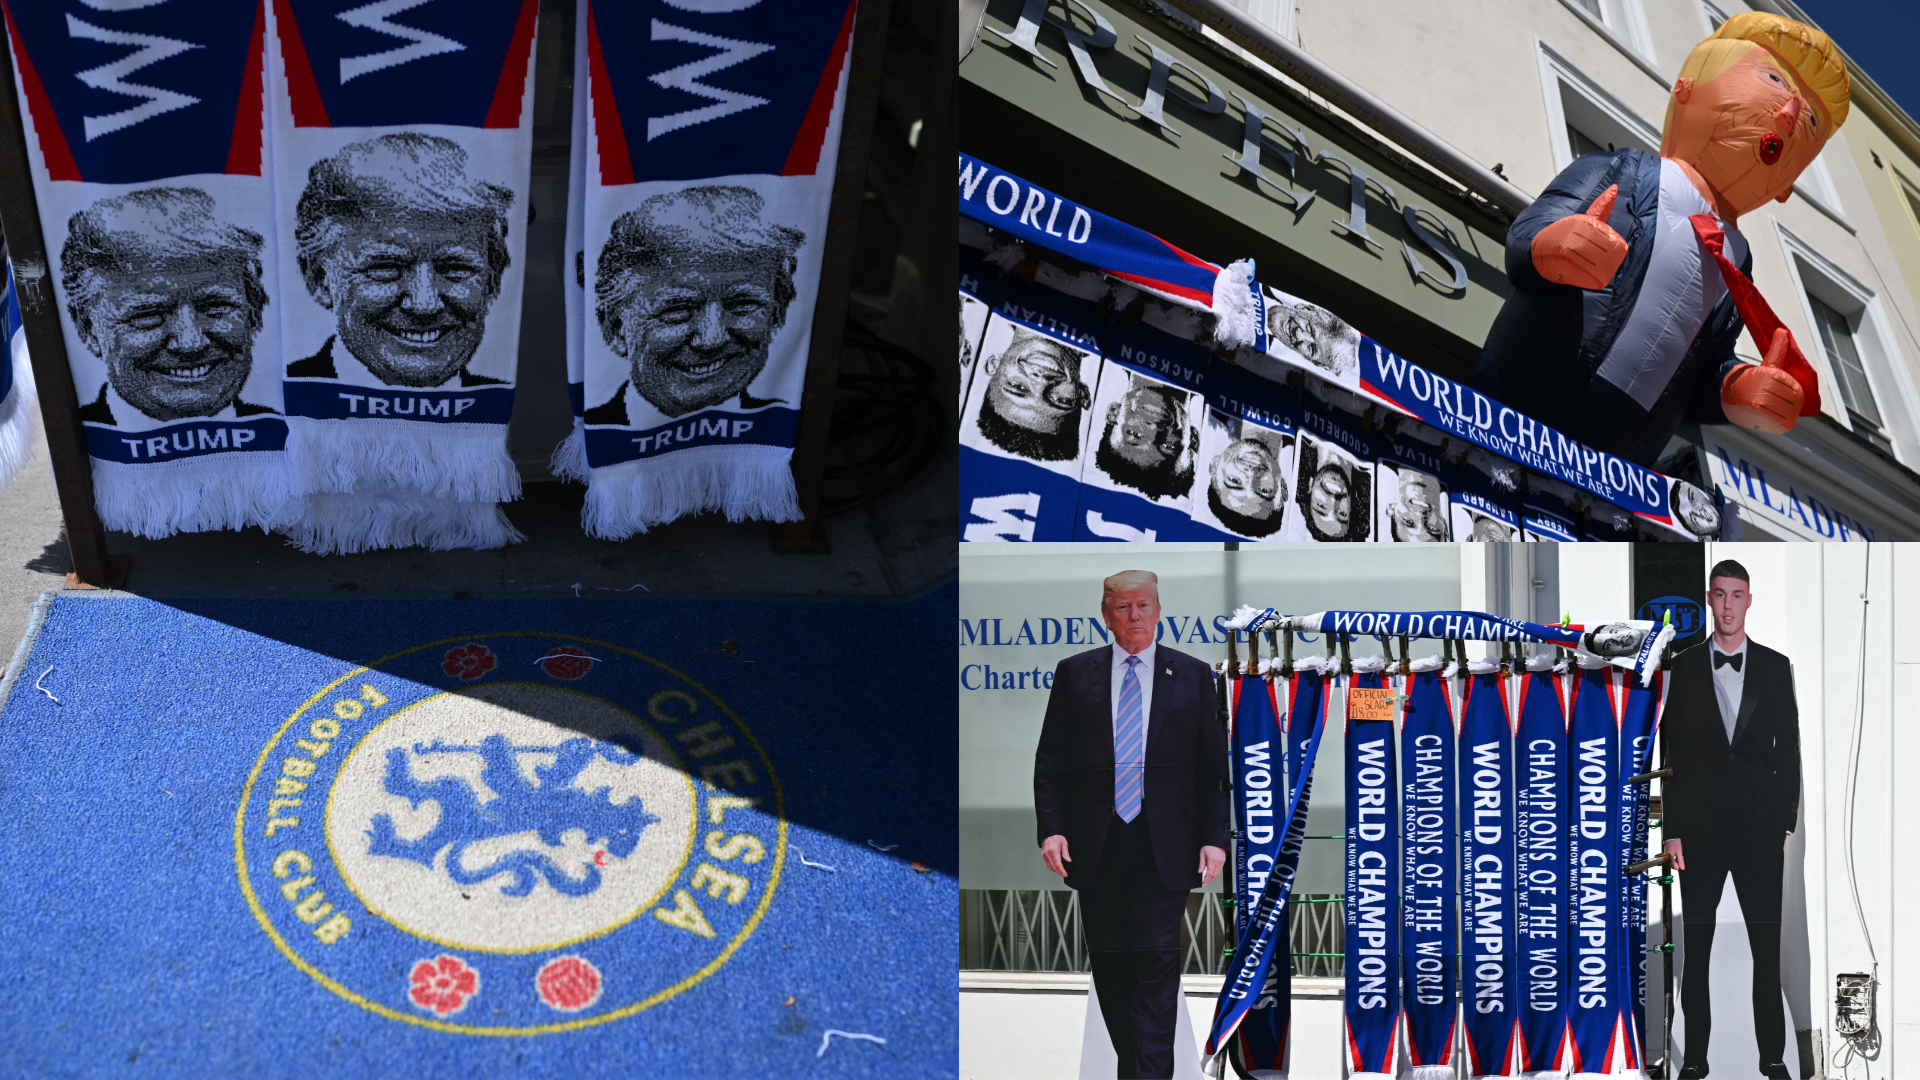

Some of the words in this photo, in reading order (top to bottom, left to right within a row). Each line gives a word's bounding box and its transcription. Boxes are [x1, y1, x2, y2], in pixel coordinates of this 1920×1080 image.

[959, 156, 1092, 244] WORLD
[1003, 301, 1099, 350] WILLIAN
[1250, 291, 1263, 337] TRUMP
[1121, 344, 1204, 385] JACKSON
[339, 393, 476, 418] TRUMP
[1219, 394, 1292, 430] COLWILL
[632, 418, 754, 453] TRUMP
[1304, 409, 1370, 455] CUCURELLA
[1373, 343, 1492, 430] WORLD
[1499, 407, 1660, 507] CHAMPIONS
[121, 428, 256, 458] TRUMP
[1394, 444, 1441, 472] SILVA
[1438, 410, 1465, 435] WE
[1468, 424, 1513, 456] KNOW
[1517, 446, 1558, 475] WHAT
[1560, 465, 1585, 486] WE
[1588, 479, 1614, 500] ARE
[1463, 491, 1514, 522] LAMPARD
[1334, 612, 1423, 637] WORLD
[1429, 613, 1532, 643] CHAMP
[1639, 631, 1658, 664] PALMER
[961, 664, 1055, 691] Charte
[265, 683, 390, 837] FOOTBALL
[1244, 741, 1274, 844] WORLD
[1358, 738, 1385, 841] WORLD
[1405, 783, 1415, 800] WE
[1415, 734, 1443, 854] CHAMPIONS
[1472, 740, 1501, 845] WORLD
[1518, 789, 1528, 806] WE
[1529, 739, 1557, 860] CHAMPIONS
[1579, 737, 1606, 839] WORLD
[1622, 784, 1631, 801] WE
[1640, 783, 1649, 799] WE
[647, 689, 765, 938] CHELSEA
[1406, 805, 1416, 842] KNOW
[1622, 806, 1631, 843] KNOW
[1634, 805, 1647, 843] KNOW
[1238, 830, 1244, 842] WE
[1348, 827, 1356, 839] WE
[1464, 830, 1472, 842] WE
[1518, 811, 1528, 848] KNOW
[1570, 825, 1578, 837] WE
[1348, 843, 1356, 867] KNOW
[1405, 846, 1415, 880] WHAT
[1464, 846, 1472, 871] KNOW
[1570, 841, 1578, 865] KNOW
[1631, 847, 1643, 880] WHT
[1348, 870, 1356, 892] WHAT
[1416, 863, 1443, 888] OF
[1464, 874, 1472, 896] WHAT
[1518, 853, 1528, 887] WHAT
[1529, 869, 1556, 895] OF
[1569, 868, 1577, 891] WHAT
[274, 849, 352, 945] CLUB
[1238, 872, 1246, 899] WHAT
[1405, 885, 1414, 901] WE
[1518, 891, 1528, 908] WE
[1569, 894, 1577, 906] WE
[1630, 885, 1640, 901] WE
[1239, 902, 1246, 915] WE
[1348, 895, 1356, 907] WE
[1405, 905, 1414, 927] ARE
[1416, 896, 1442, 932] THE
[1464, 900, 1472, 913] WE
[1239, 916, 1247, 931] ARE
[1348, 911, 1356, 925] ARE
[1358, 851, 1386, 1010] CHAMPIONS
[1464, 916, 1472, 932] ARE
[1519, 912, 1528, 934] ARE
[1529, 903, 1556, 939] THE
[1569, 910, 1577, 925] ARE
[1579, 849, 1607, 1009] CHAMPIONS
[1630, 906, 1640, 928] ARE
[1474, 854, 1504, 1014] CHAMPIONS
[1416, 941, 1443, 1005] WORLD
[1529, 948, 1557, 1011] WORLD
